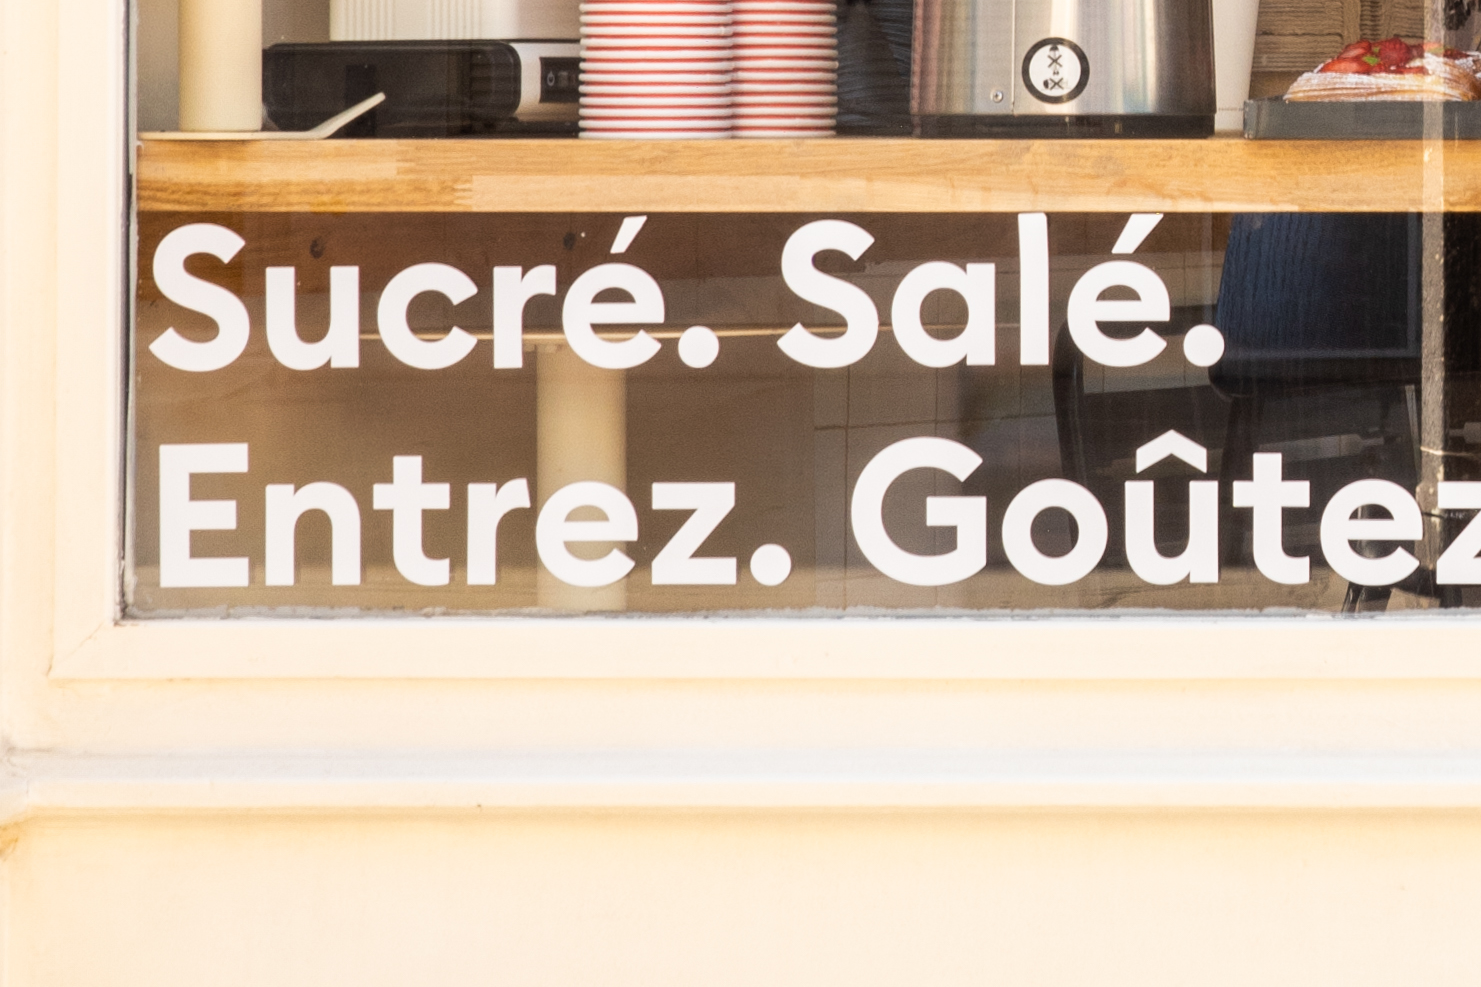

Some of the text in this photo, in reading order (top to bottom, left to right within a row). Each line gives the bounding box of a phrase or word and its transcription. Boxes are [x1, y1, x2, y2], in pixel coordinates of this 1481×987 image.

[149, 212, 1225, 372] Sucré. Salé.
[159, 443, 792, 588] Entrez.
